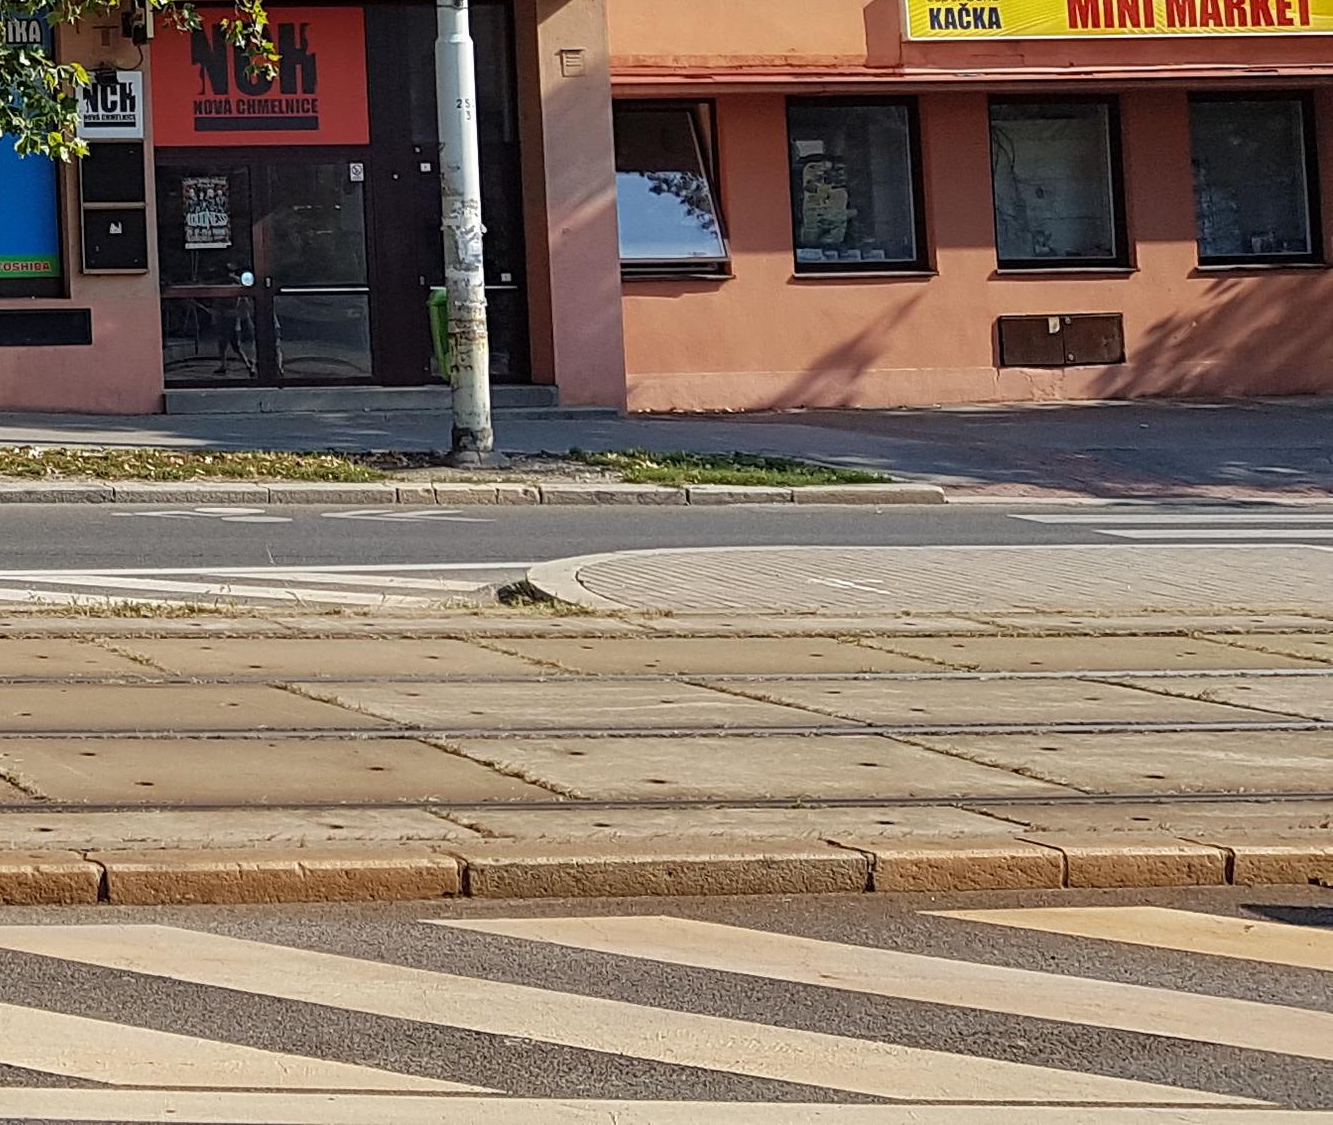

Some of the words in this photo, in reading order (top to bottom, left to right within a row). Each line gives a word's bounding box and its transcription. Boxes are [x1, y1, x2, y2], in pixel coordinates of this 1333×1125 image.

[928, 2, 1003, 31] KAČKA
[190, 22, 319, 97] NCH
[83, 82, 137, 114] NCH
[193, 96, 233, 116] NOVÁ
[235, 98, 319, 115] CHMELNICE
